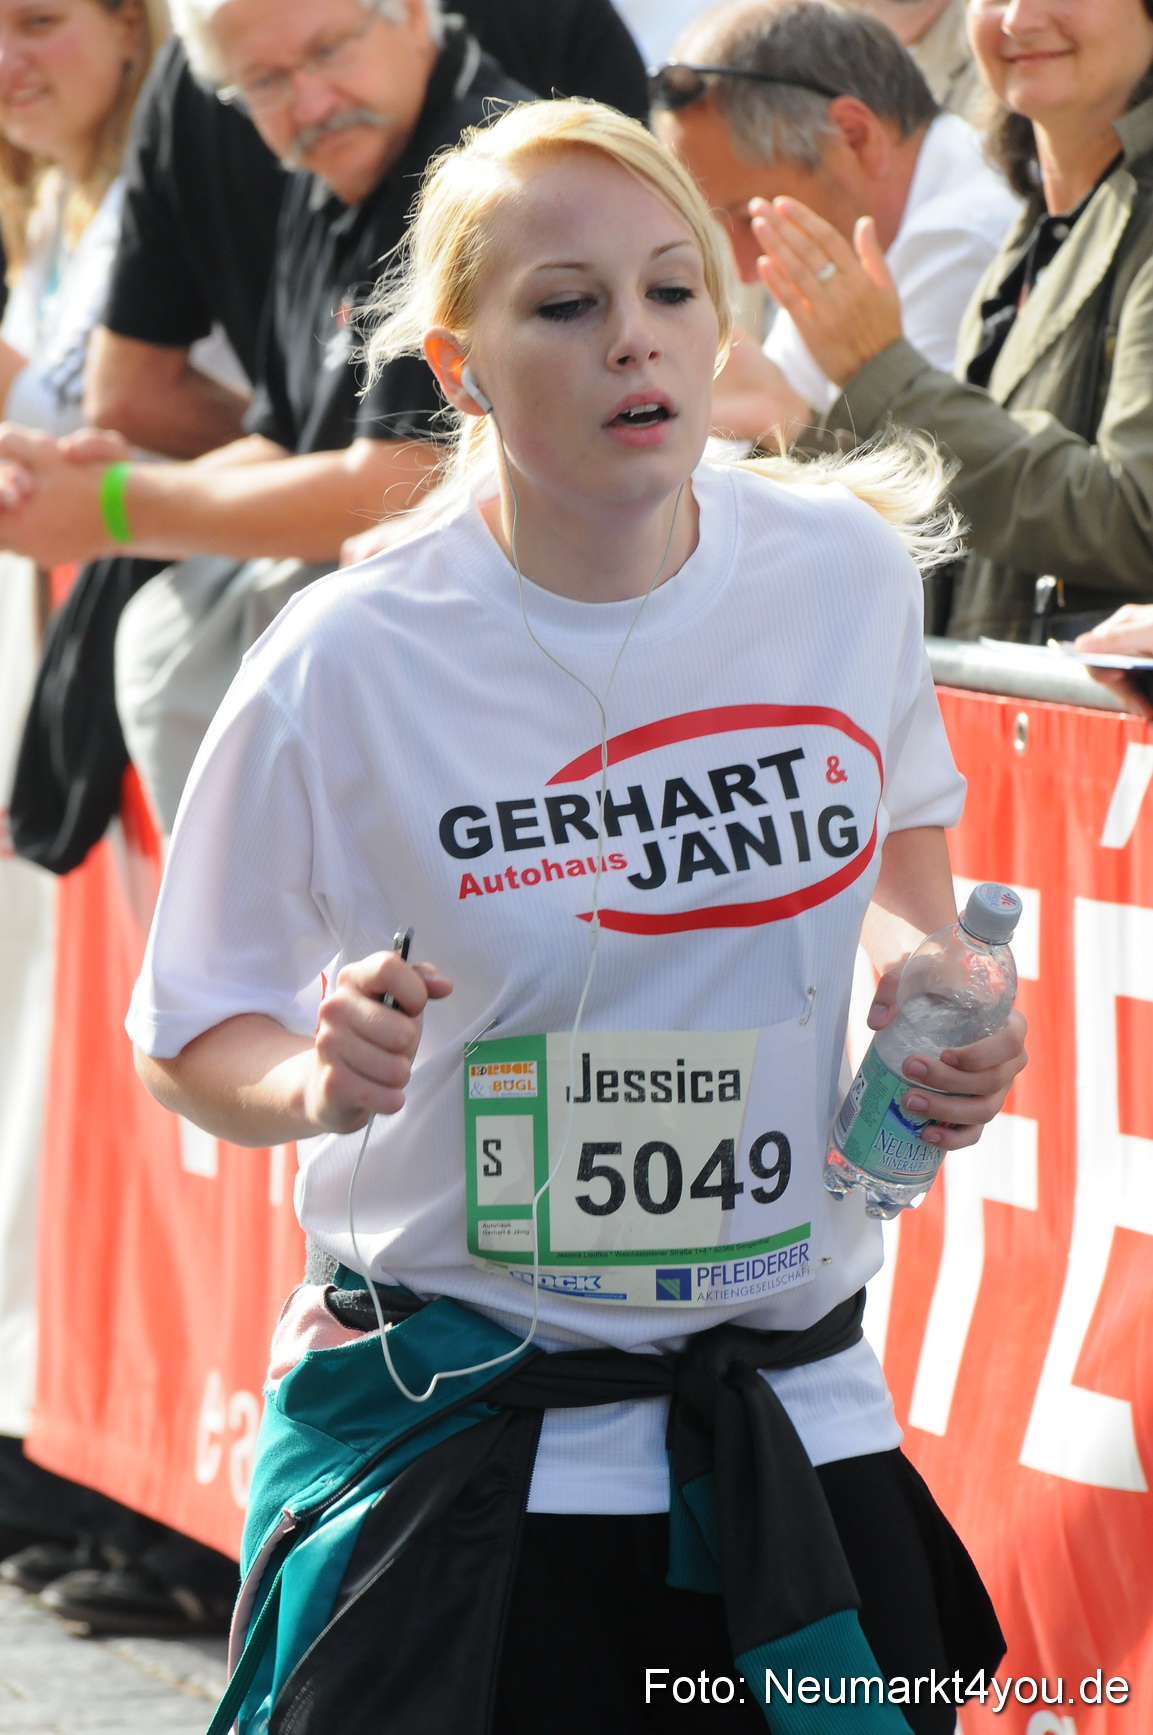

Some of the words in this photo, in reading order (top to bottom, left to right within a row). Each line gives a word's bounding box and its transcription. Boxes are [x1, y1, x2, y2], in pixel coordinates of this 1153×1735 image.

[438, 747, 806, 860] GERHART
[825, 755, 848, 784] &
[627, 804, 860, 890] JÄNIG
[458, 852, 628, 900] Autohaus
[492, 1079, 536, 1092] BÖGL
[566, 1052, 741, 1103] Jessica
[482, 1138, 502, 1177] S
[575, 1130, 792, 1217] 5049
[697, 1242, 810, 1287] PFLEIDERER
